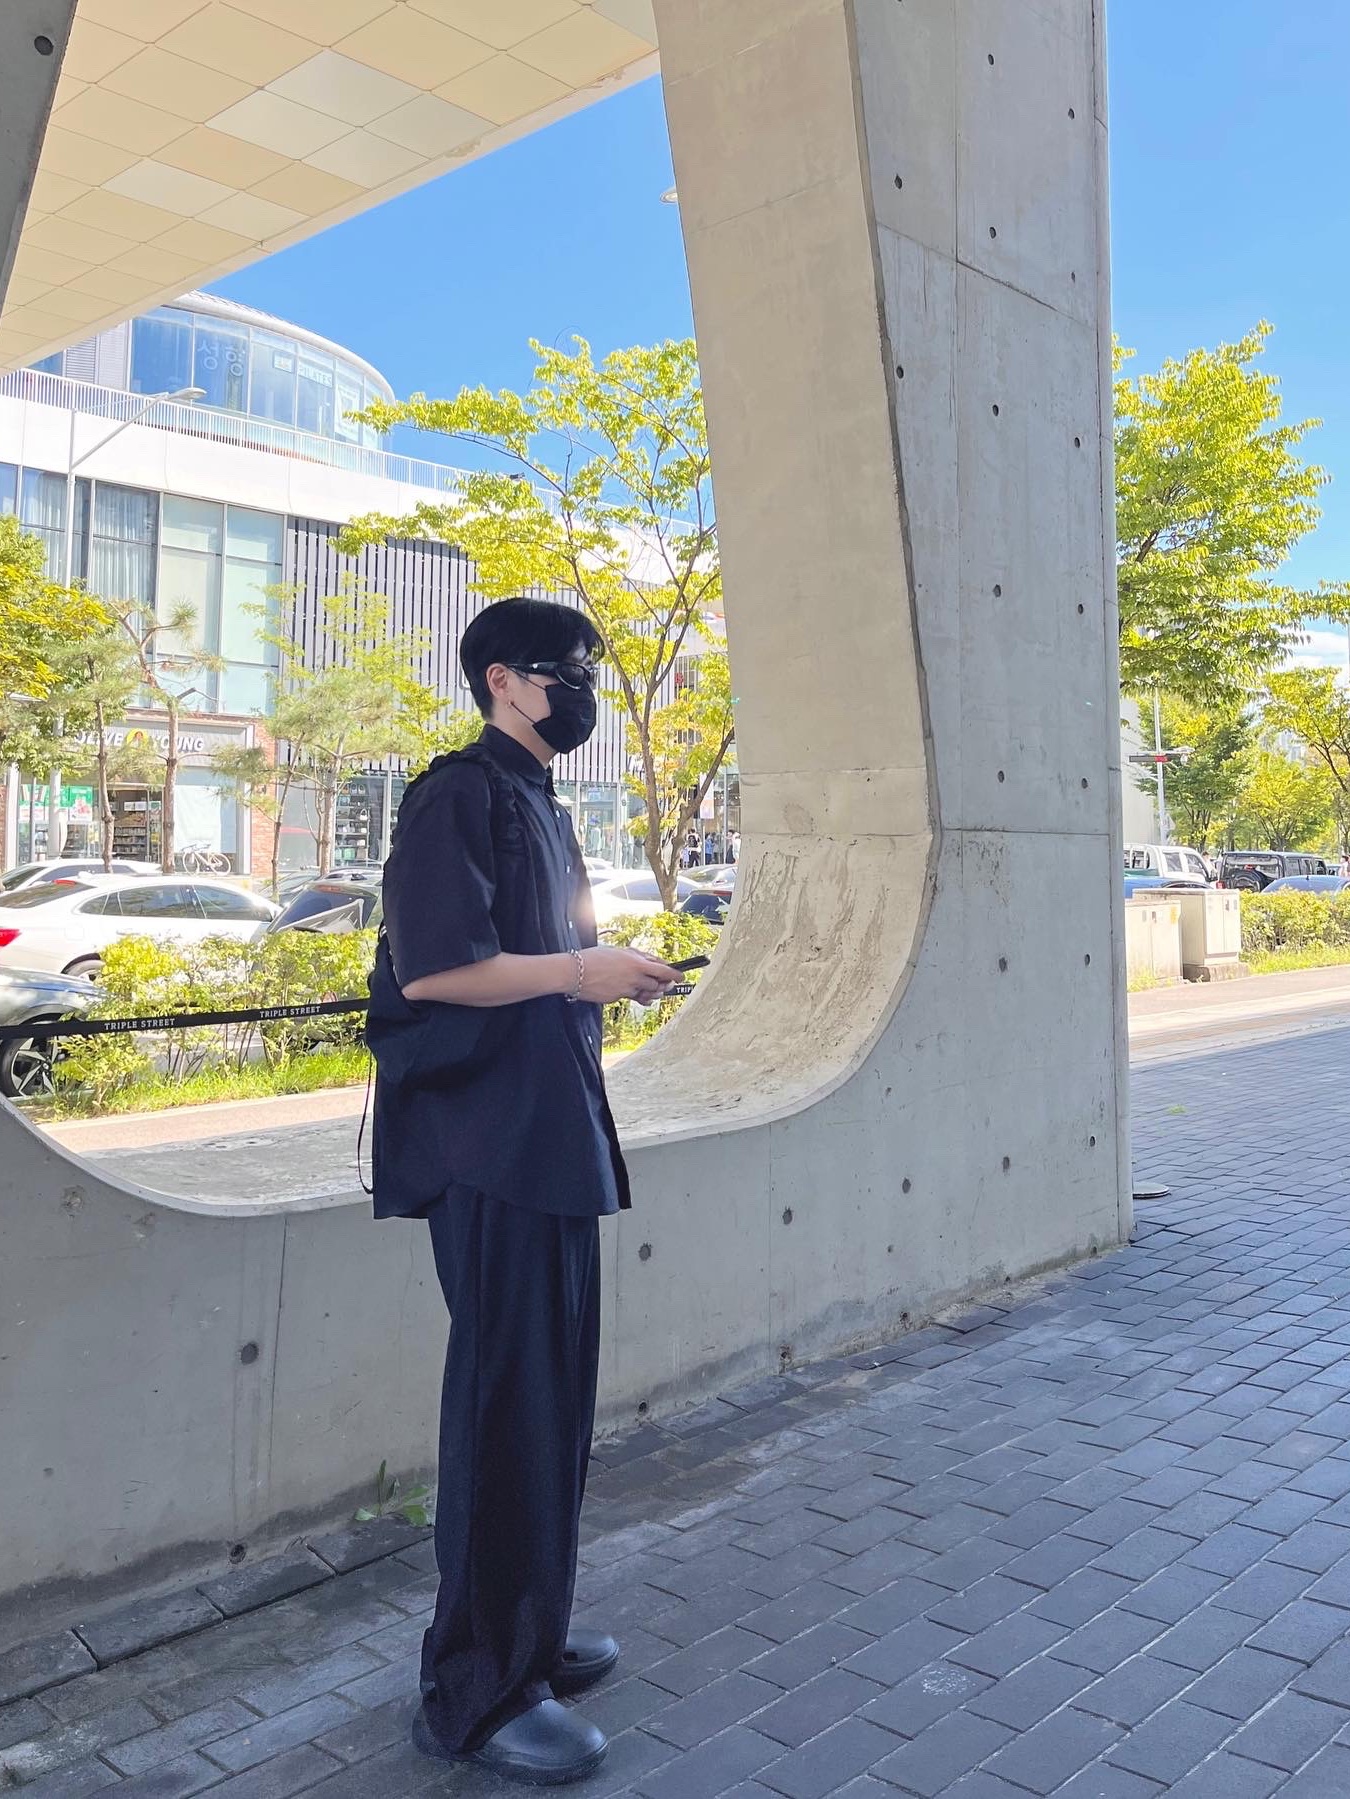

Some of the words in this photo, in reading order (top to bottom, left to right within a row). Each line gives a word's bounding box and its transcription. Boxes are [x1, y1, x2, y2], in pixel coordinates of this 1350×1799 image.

[260, 1009, 288, 1018] TRIPLE
[290, 1006, 321, 1016] STREET
[104, 1020, 138, 1030] TRIPLE
[141, 1018, 176, 1028] STREET
